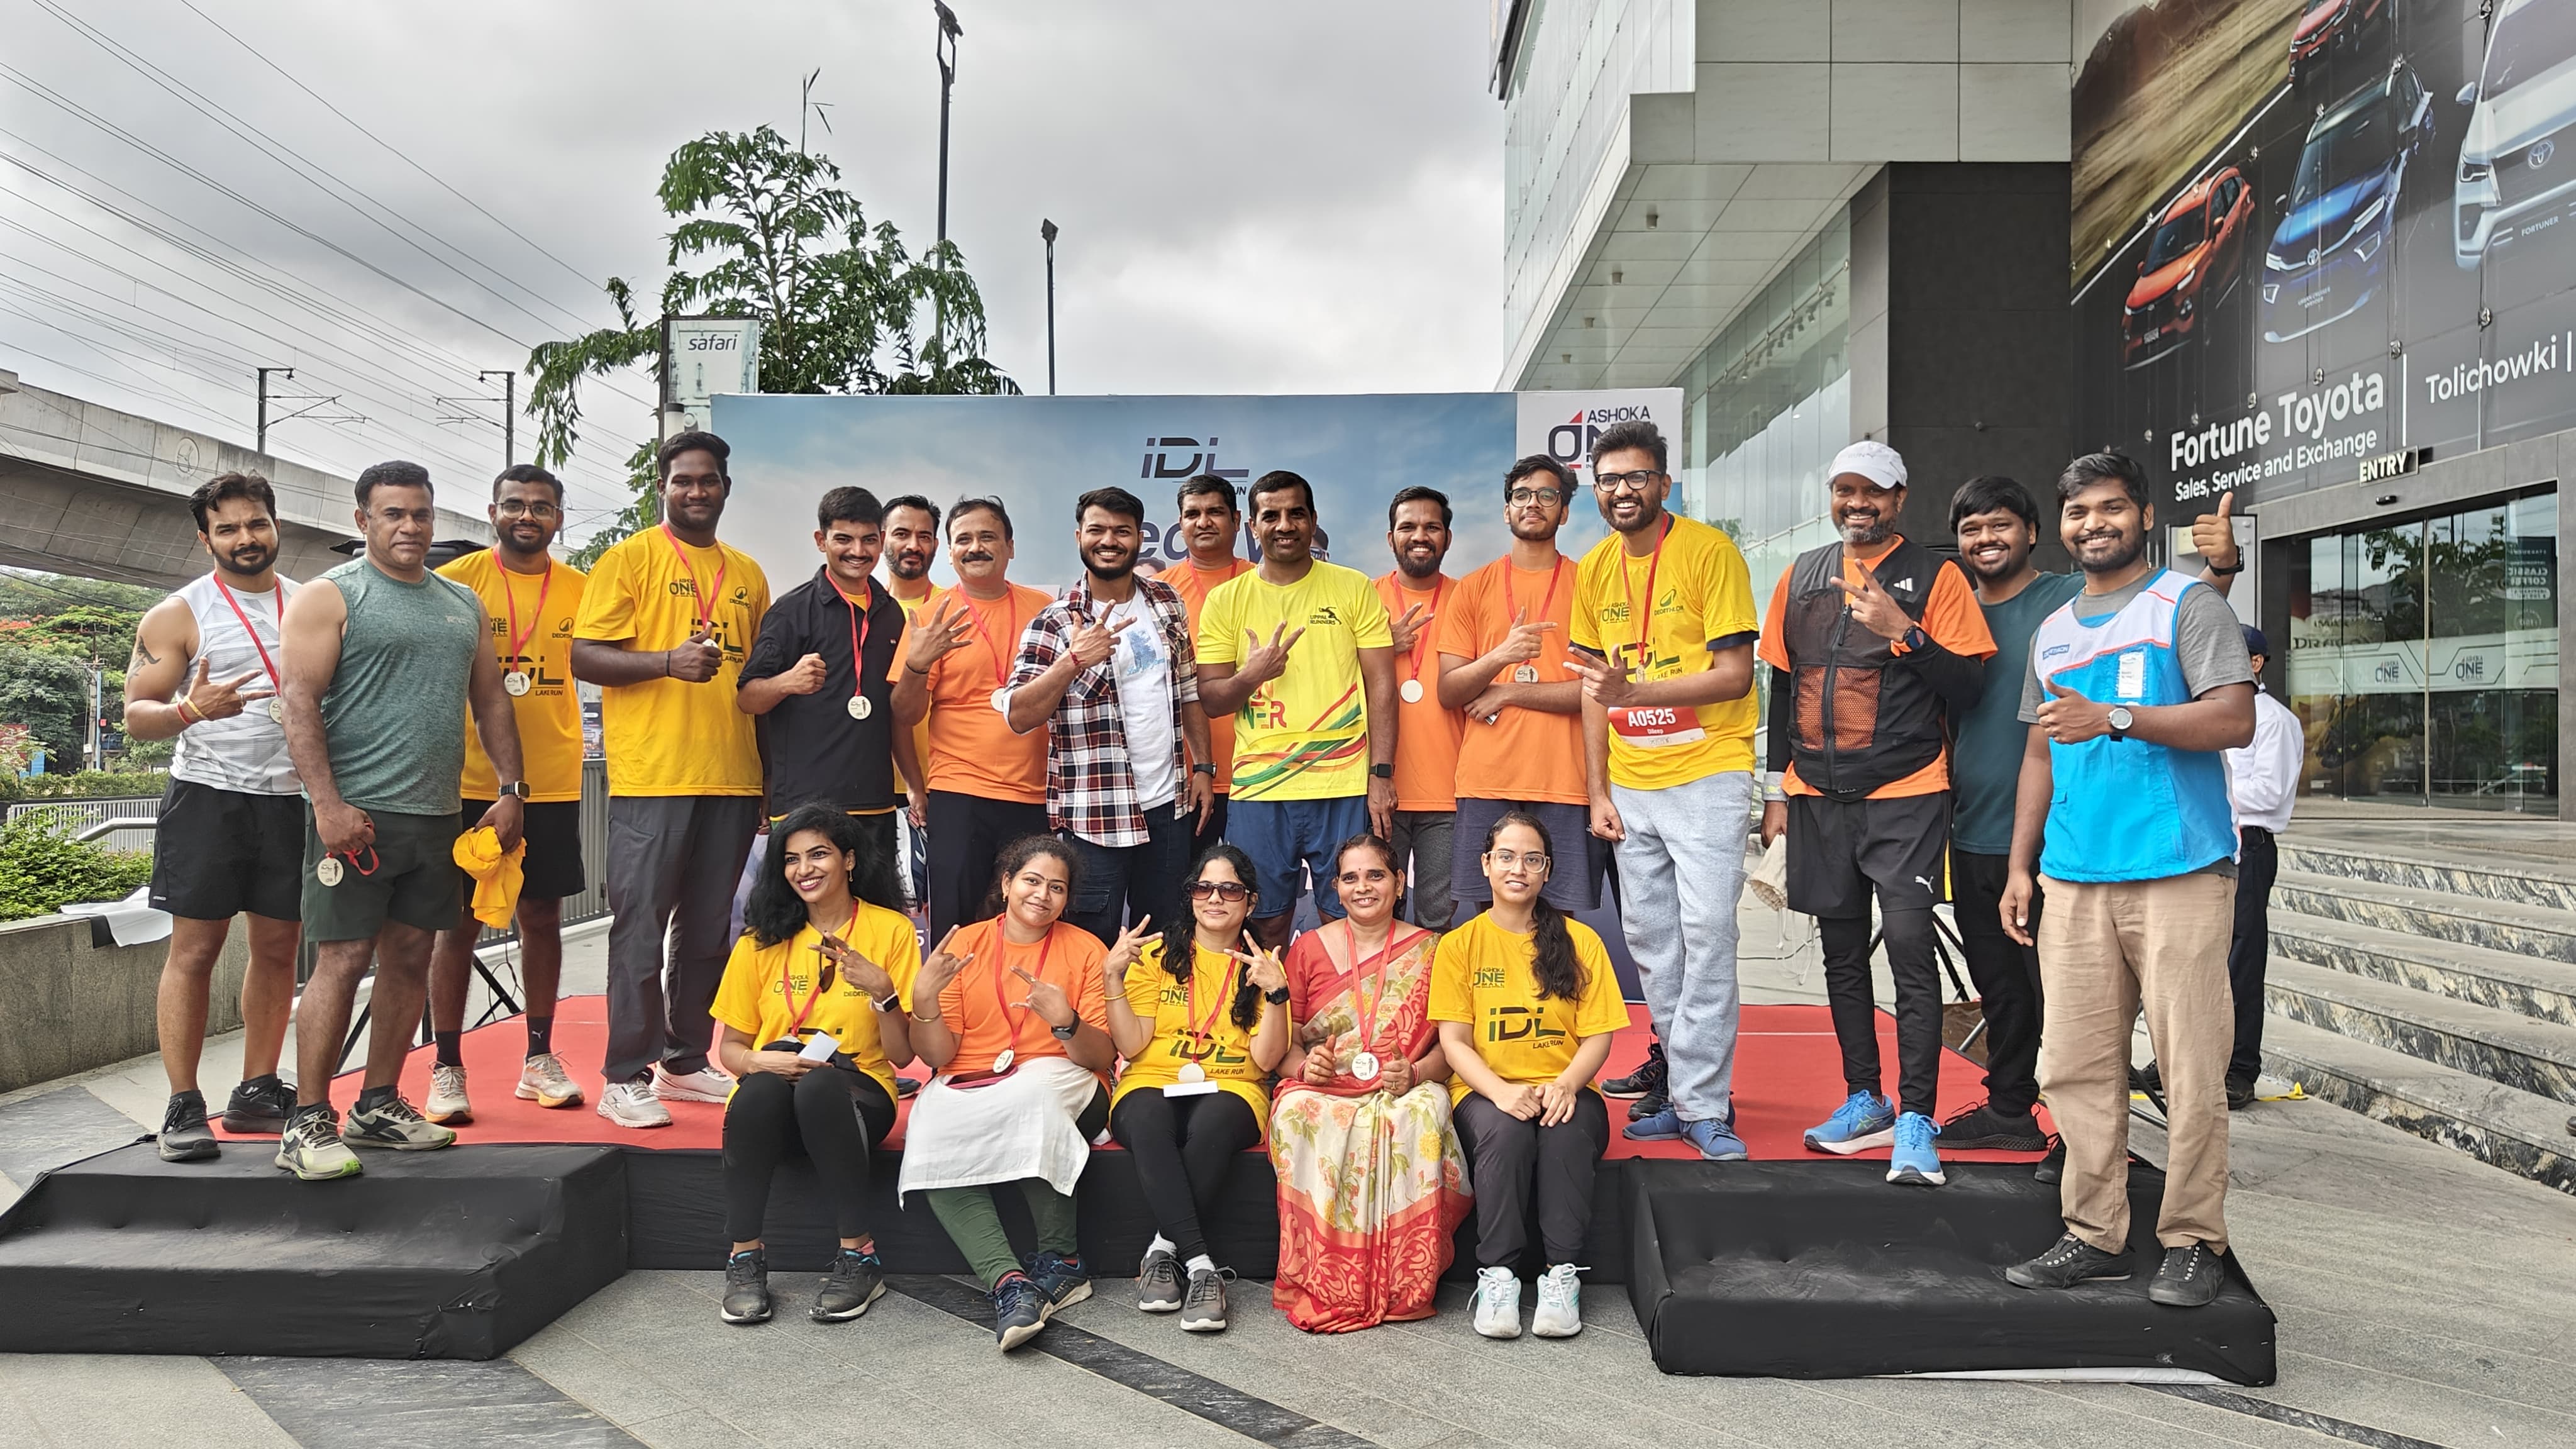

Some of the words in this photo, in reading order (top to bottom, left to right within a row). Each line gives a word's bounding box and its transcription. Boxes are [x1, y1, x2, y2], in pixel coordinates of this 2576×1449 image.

[2521, 216, 2559, 236] FORTUNER
[688, 334, 738, 350] safari
[2426, 335, 2557, 404] Tolichowki
[1587, 406, 1650, 423] ASHOKA
[2171, 411, 2270, 471] Fortune
[2278, 372, 2384, 438] Toyota
[2175, 474, 2209, 502] Sales,
[2212, 460, 2261, 491] Service
[2265, 448, 2292, 477] and
[2297, 428, 2377, 469] Exchange
[2360, 452, 2407, 484] ENTRY
[1655, 606, 1684, 616] DECATHLON
[1670, 667, 1683, 675] RUN
[2375, 667, 2399, 682] ONE
[2456, 662, 2483, 680] ONE
[1243, 701, 1287, 729] NER
[1628, 708, 1676, 728] A0525
